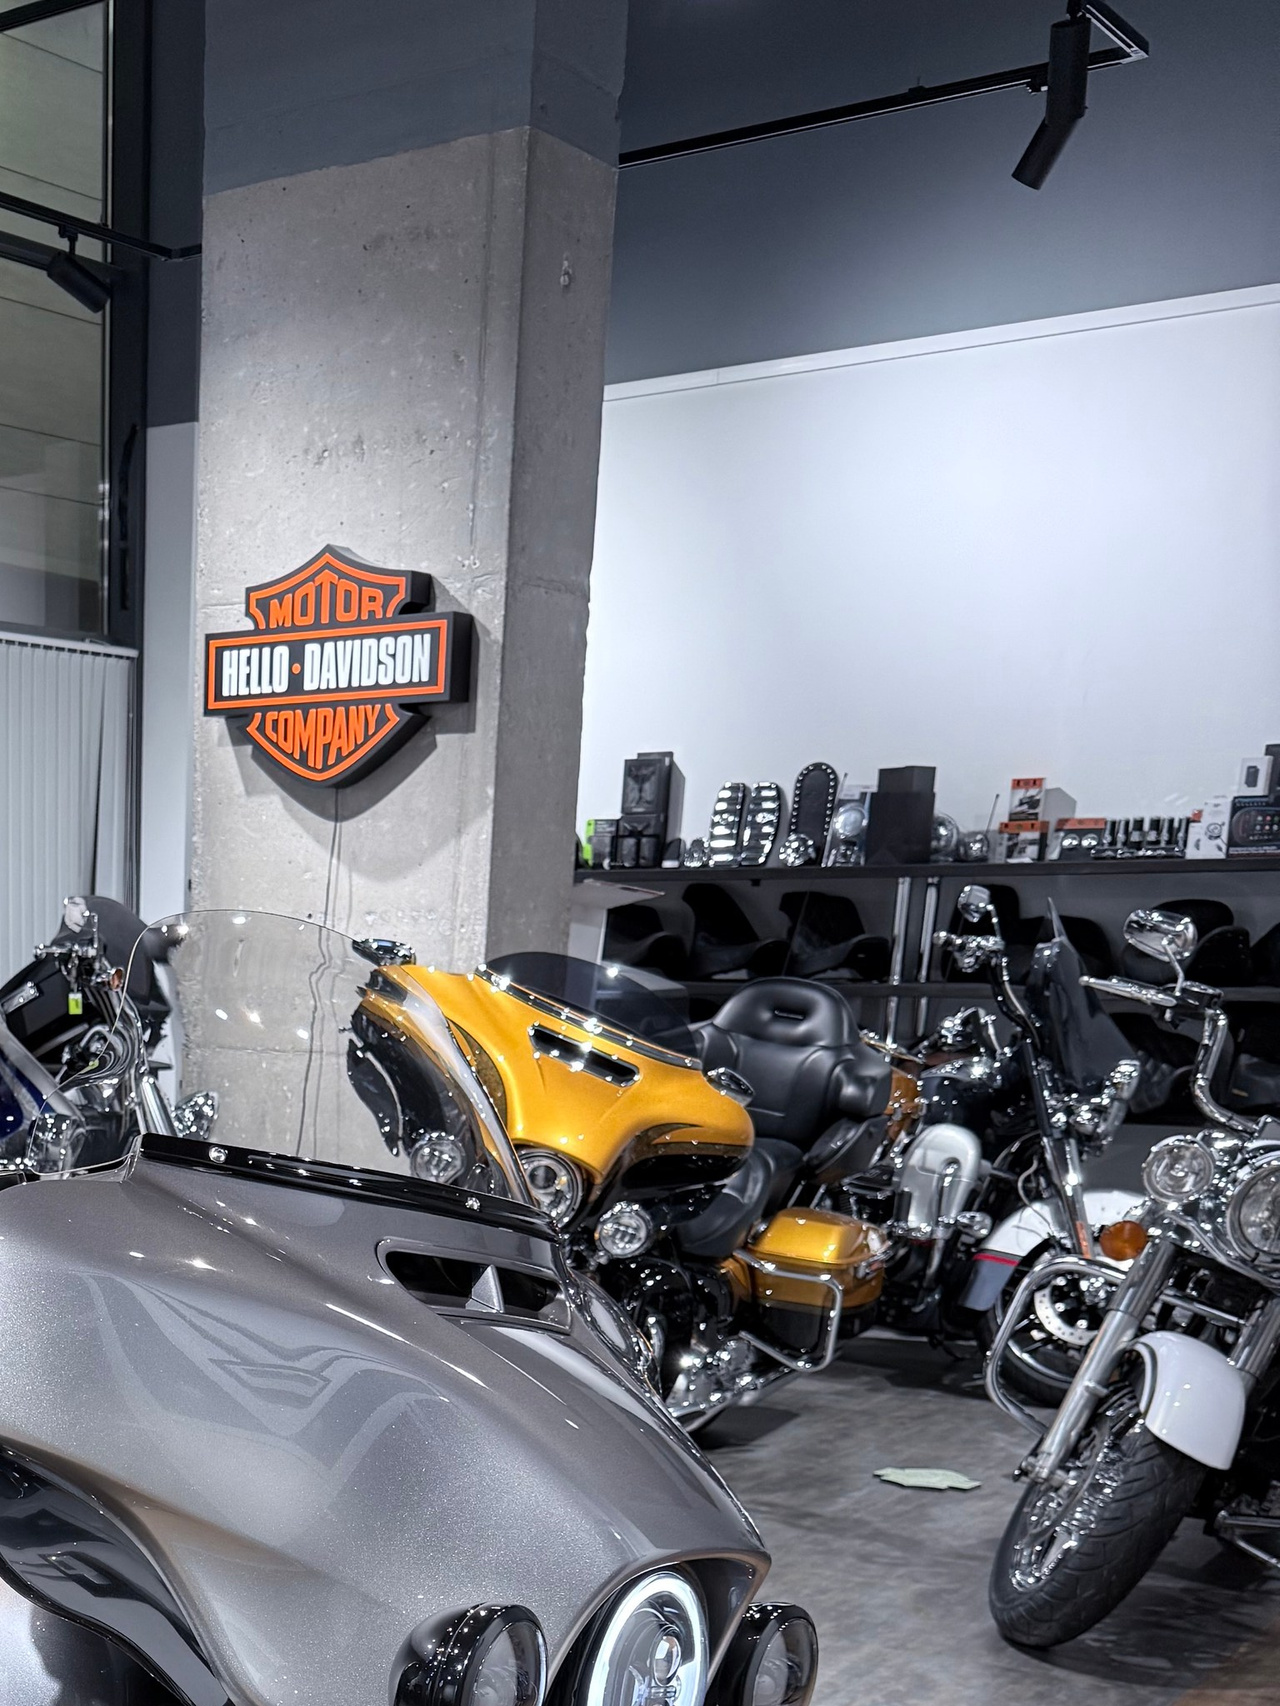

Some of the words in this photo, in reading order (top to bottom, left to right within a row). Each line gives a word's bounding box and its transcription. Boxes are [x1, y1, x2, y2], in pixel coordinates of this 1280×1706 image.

[269, 569, 383, 629] MOTOR
[222, 645, 289, 697] HELLO
[303, 633, 431, 691] DAVIDSON
[265, 703, 381, 769] COMPANY
